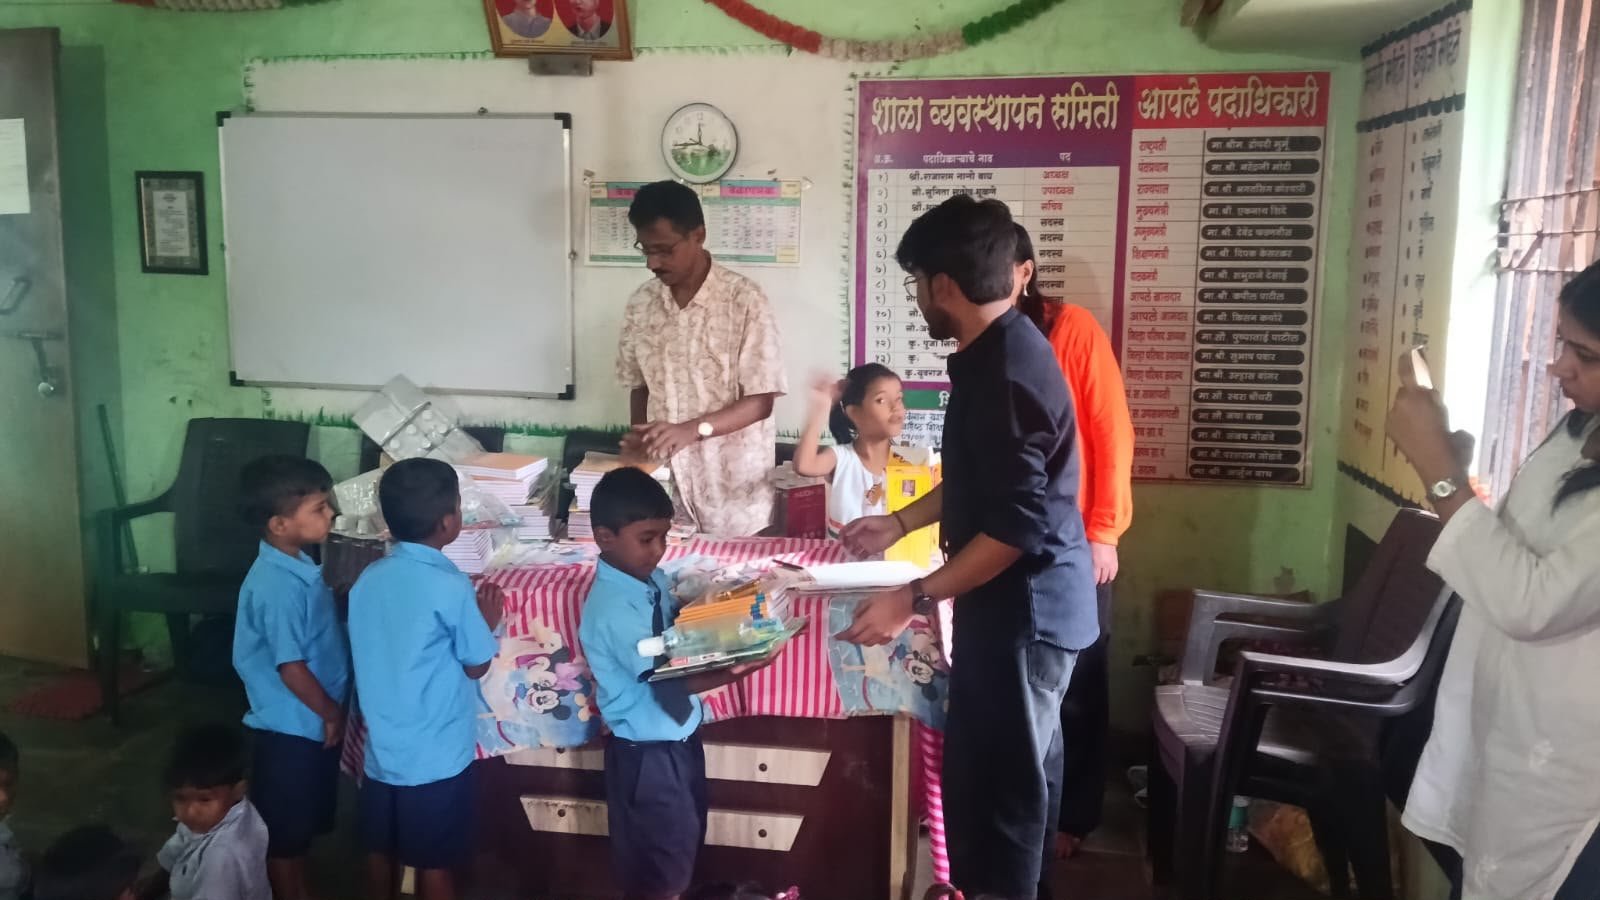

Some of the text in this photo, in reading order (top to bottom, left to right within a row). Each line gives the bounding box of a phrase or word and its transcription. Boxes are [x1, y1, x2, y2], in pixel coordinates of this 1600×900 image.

[1138, 75, 1319, 120] आपले पदाधिकारी
[871, 80, 1120, 135] शाळा व्यवस्थापन समिती
[1059, 152, 1072, 162] पद
[1041, 200, 1064, 210] सचिव
[1040, 218, 1065, 227] सदस्य
[1040, 233, 1065, 242] सदस्य
[1039, 249, 1064, 258] सदस्य
[1038, 265, 1066, 274] सदस्या
